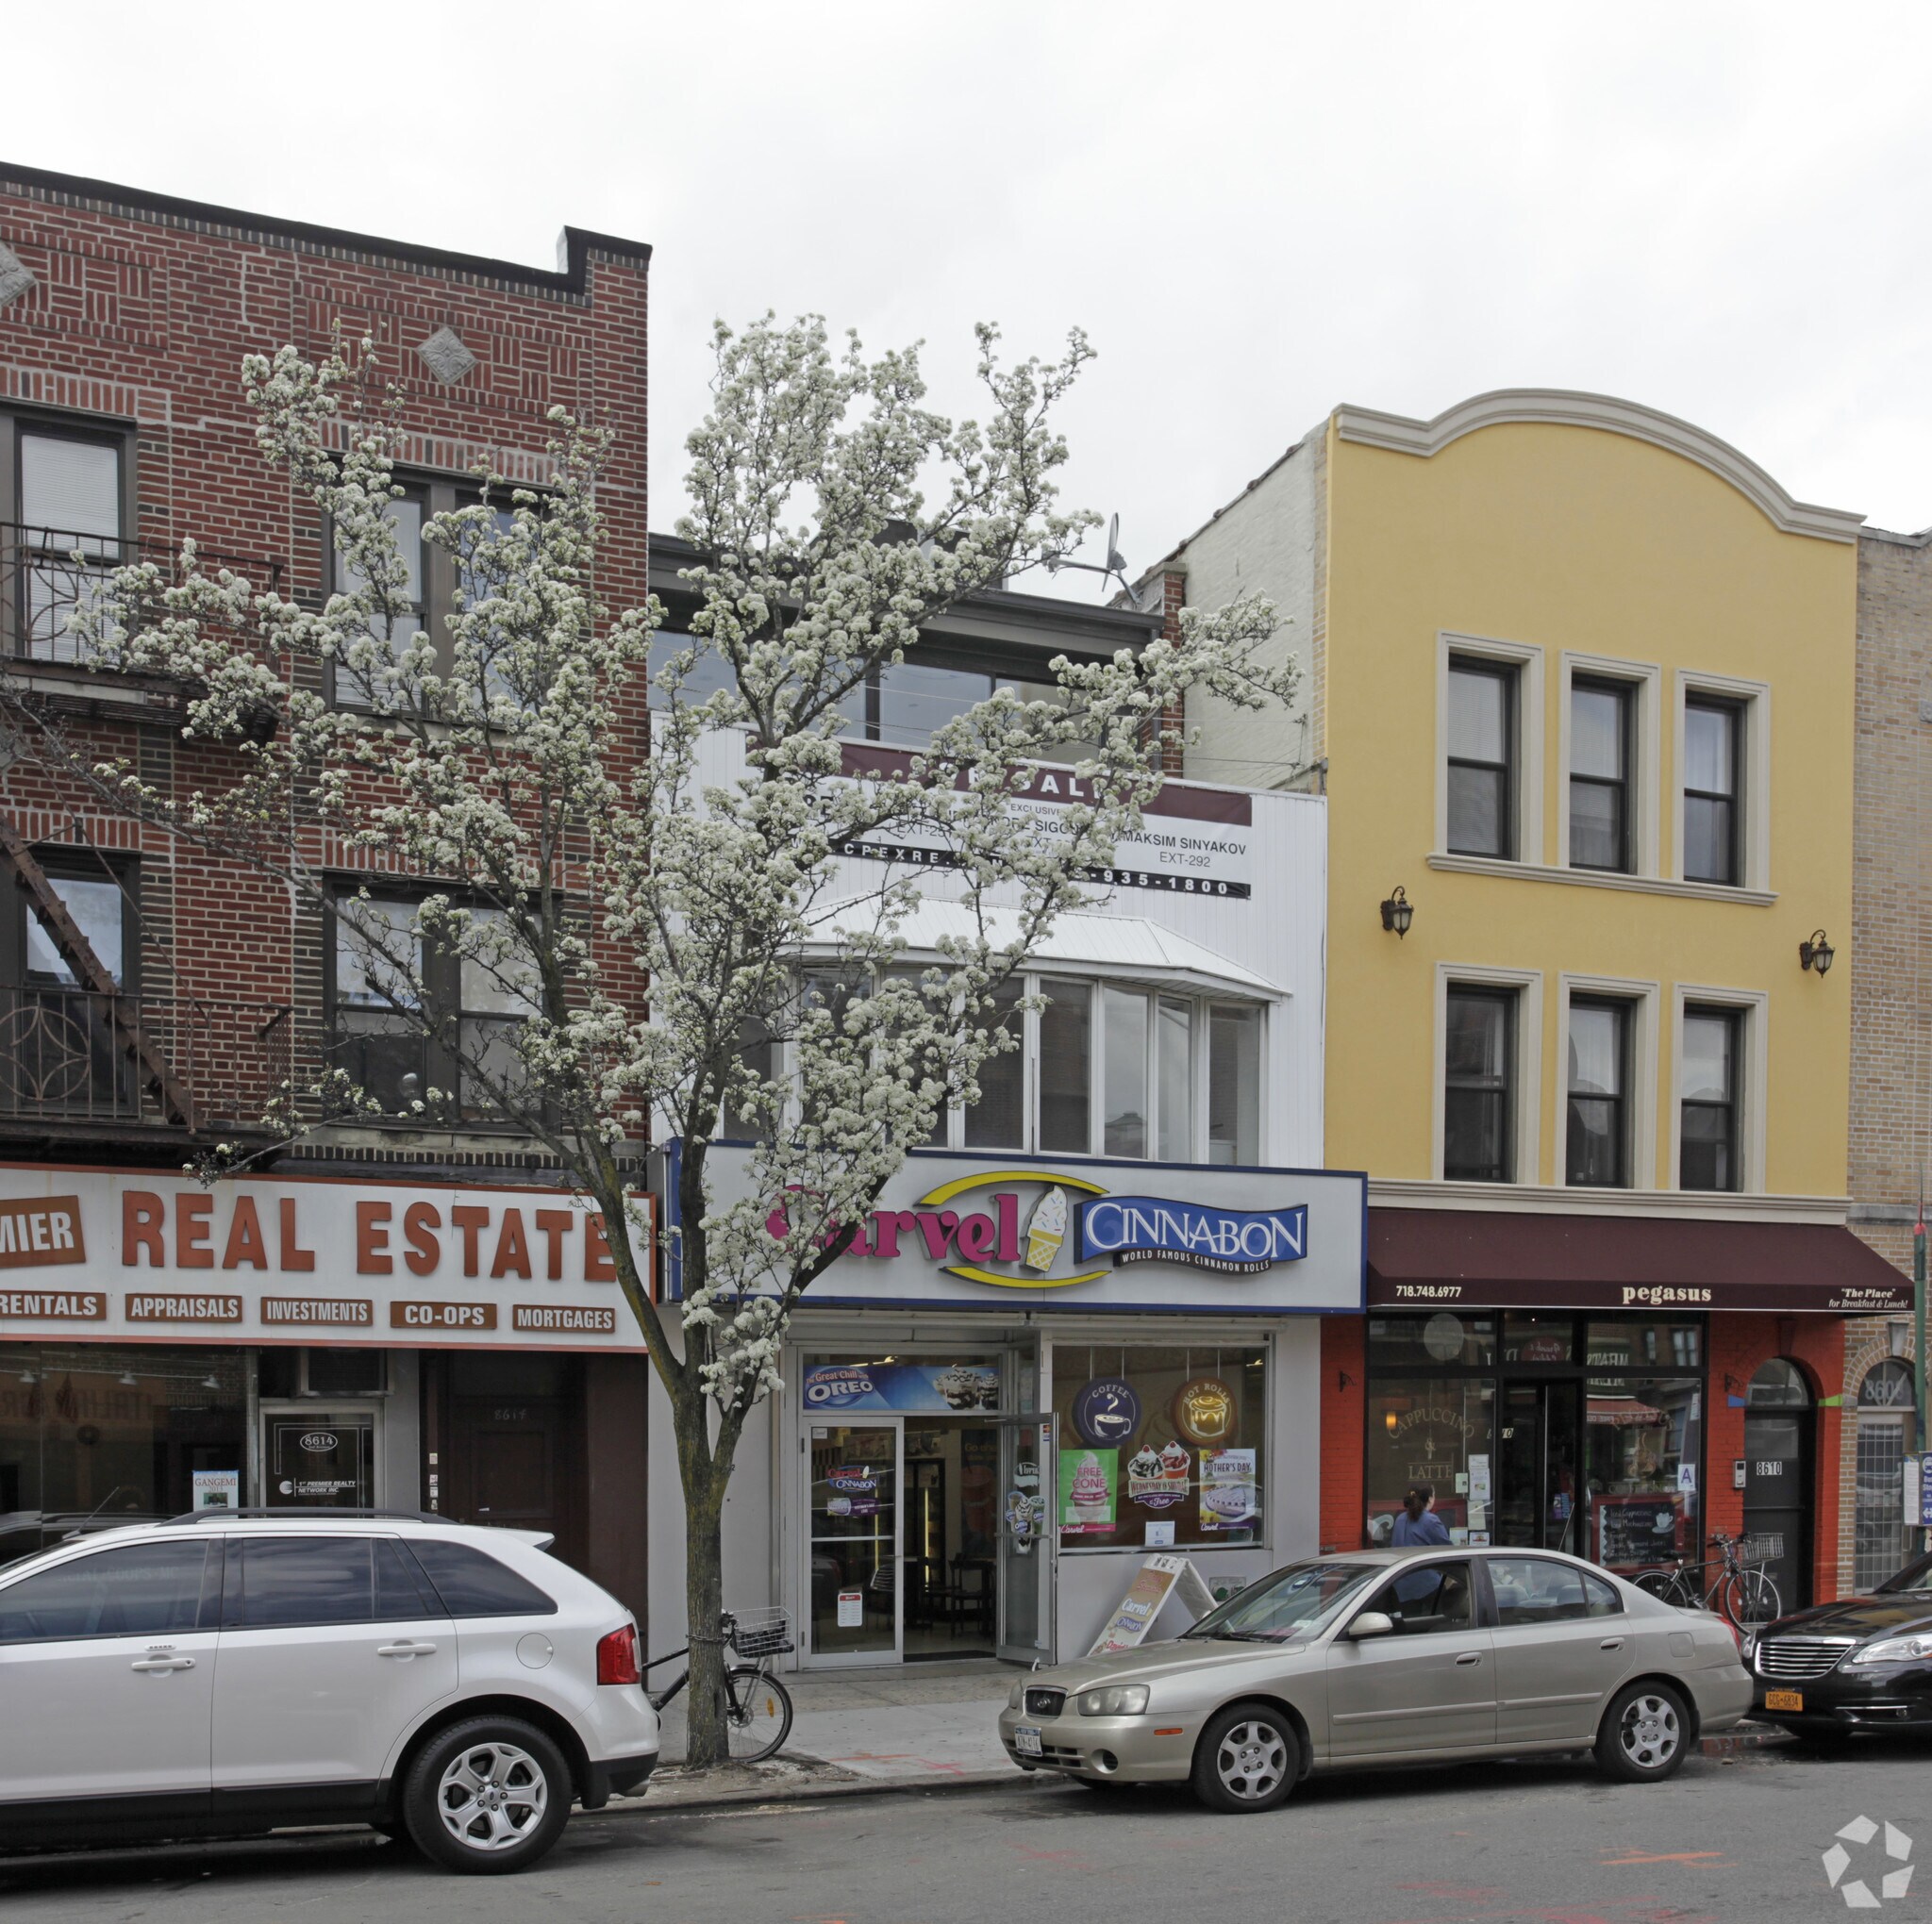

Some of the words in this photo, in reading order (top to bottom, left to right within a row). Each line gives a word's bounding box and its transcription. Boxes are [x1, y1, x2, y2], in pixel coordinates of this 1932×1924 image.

[1180, 838, 1247, 855] SINYAKOV
[1159, 851, 1211, 868] EXT-292
[122, 1190, 315, 1271] REAL
[357, 1201, 619, 1283] ESTATE
[1085, 1202, 1304, 1259] CINNABON
[1122, 1250, 1153, 1264] WORLD
[1157, 1250, 1191, 1264] FAMOUS
[1194, 1254, 1241, 1272] CINNAMON
[1243, 1259, 1270, 1272] ROLLS
[1396, 1285, 1462, 1298] 718.748.6977
[1622, 1285, 1713, 1305] pegasus
[0, 1294, 97, 1317] RENTALS
[131, 1297, 239, 1319] APPRAISALS
[267, 1300, 368, 1322] INVESTMENTS
[1828, 1299, 1840, 1309] for
[1841, 1299, 1875, 1309] Breakfast
[1876, 1300, 1883, 1308] &
[1884, 1300, 1908, 1309] Lunch!
[405, 1304, 485, 1326] CO-OPS
[517, 1307, 613, 1330] MORTGAGES
[815, 1370, 838, 1383] Great
[839, 1369, 858, 1380] Chill
[807, 1380, 874, 1402] OREO
[1091, 1384, 1130, 1399] COFFEE
[1183, 1385, 1200, 1405] HOT
[1204, 1383, 1230, 1404] ROLLS
[1388, 1407, 1474, 1439] CAPPUCCINO
[305, 1435, 334, 1446] 8614
[1076, 1467, 1102, 1477] FREE
[1204, 1462, 1237, 1472] MOTHER'S
[1238, 1462, 1252, 1472] DAY
[1408, 1465, 1453, 1480] LATTE
[1757, 1462, 1782, 1475] 8610
[194, 1477, 237, 1487] GANGEMI
[1072, 1478, 1106, 1489] CONE
[1680, 1468, 1692, 1484] A
[1122, 1598, 1151, 1617] Carvel
